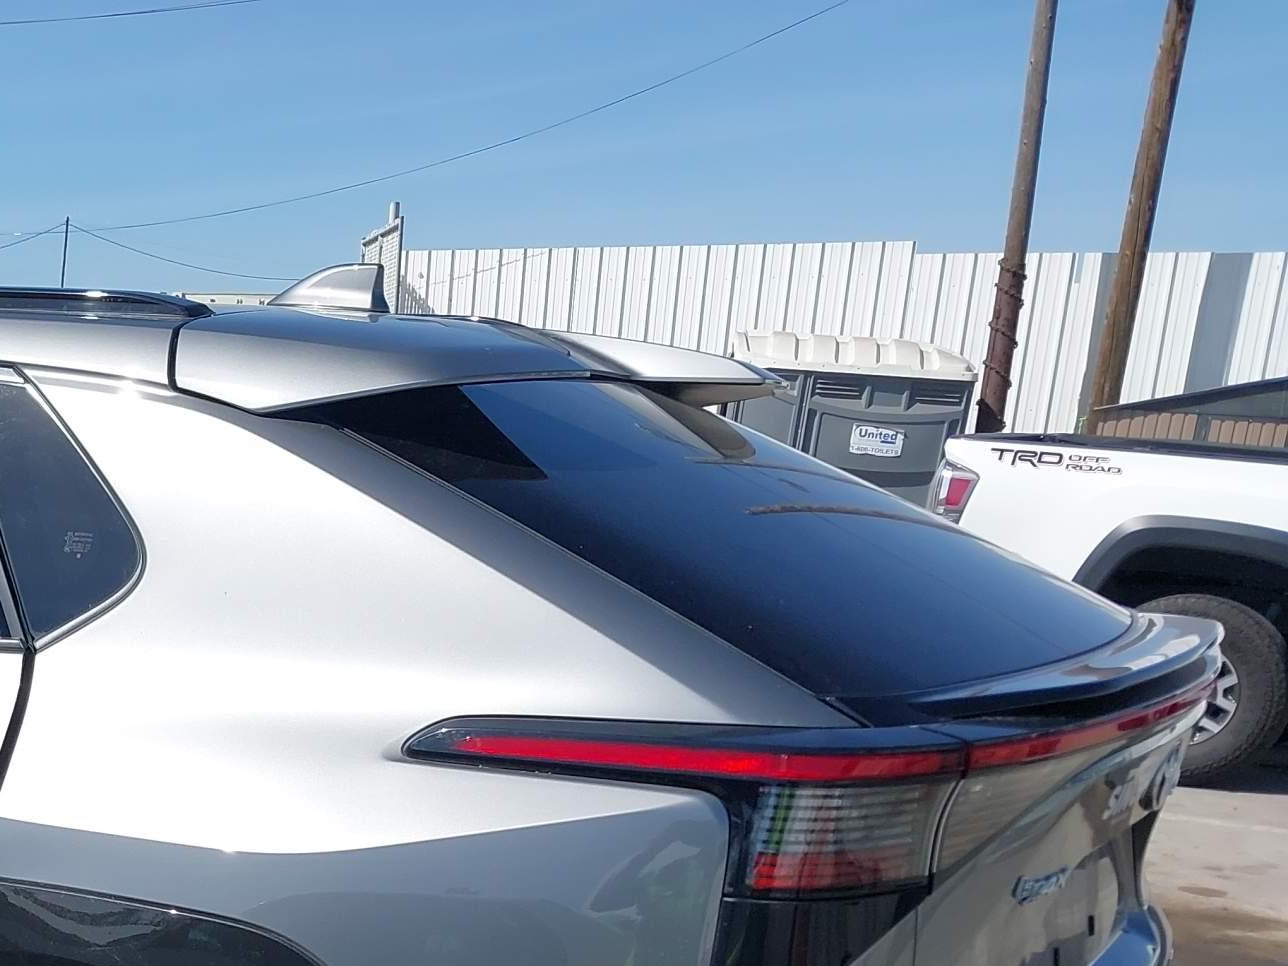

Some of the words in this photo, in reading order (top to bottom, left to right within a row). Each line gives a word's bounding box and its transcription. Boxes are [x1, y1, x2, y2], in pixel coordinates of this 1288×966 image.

[858, 427, 899, 441] United
[991, 447, 1064, 468] TRD
[1068, 454, 1111, 463] OFF
[1065, 463, 1122, 474] ROAD
